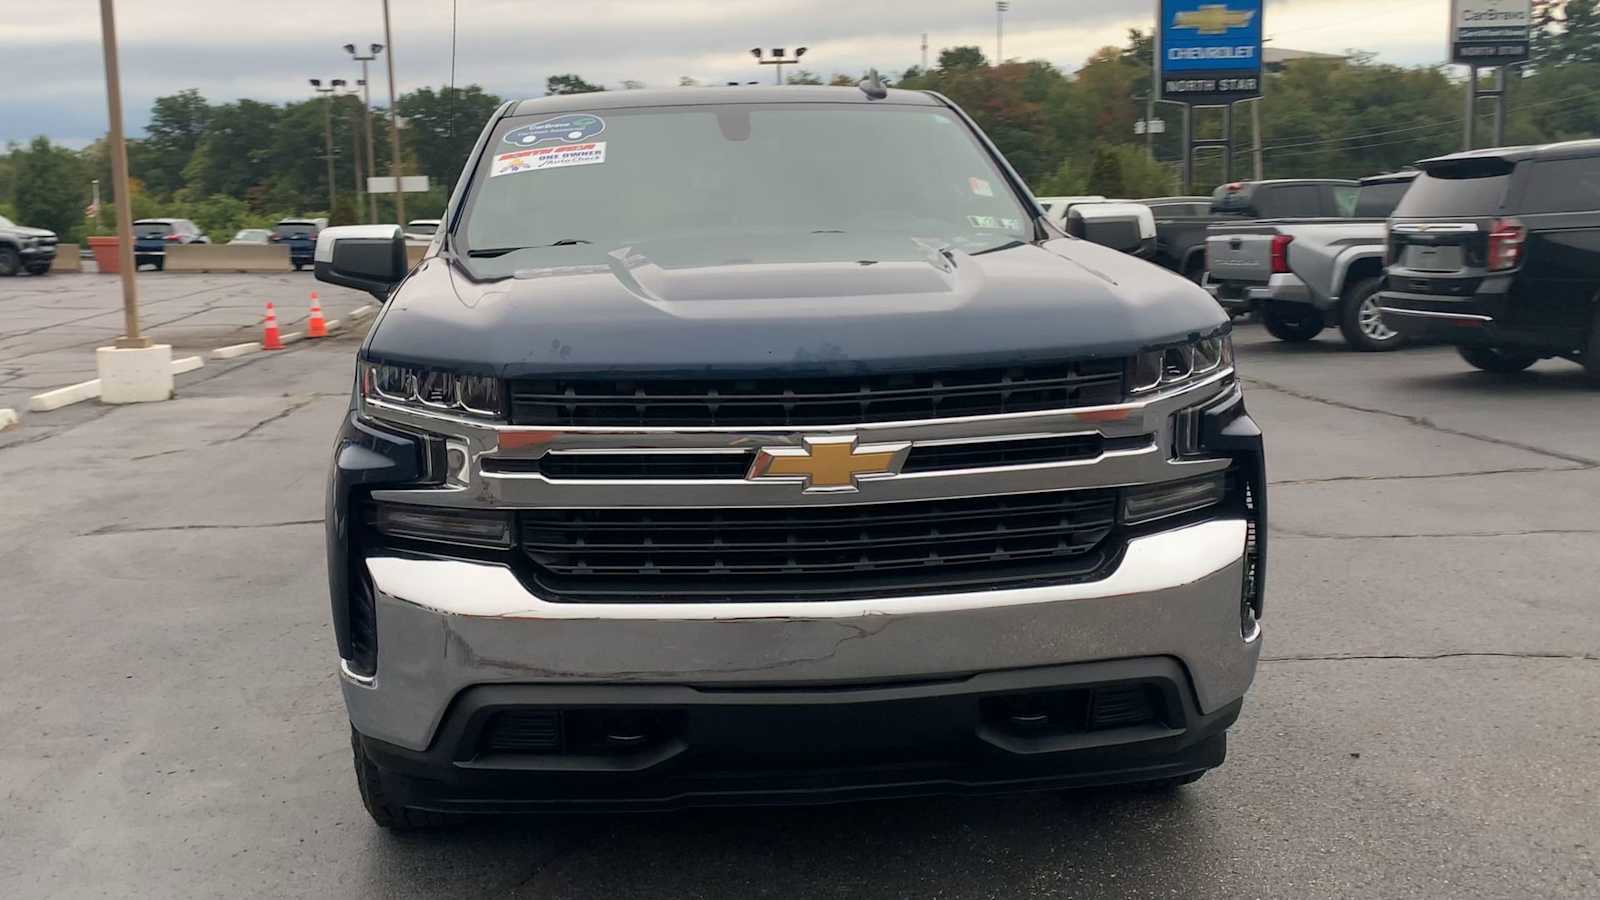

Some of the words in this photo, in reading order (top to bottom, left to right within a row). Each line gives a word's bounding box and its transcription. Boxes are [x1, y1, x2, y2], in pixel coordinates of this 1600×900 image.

[1167, 46, 1256, 60] CHEVROLET
[1166, 80, 1216, 92] NORTH
[1218, 79, 1257, 91] STAR
[562, 150, 602, 159] OWNER
